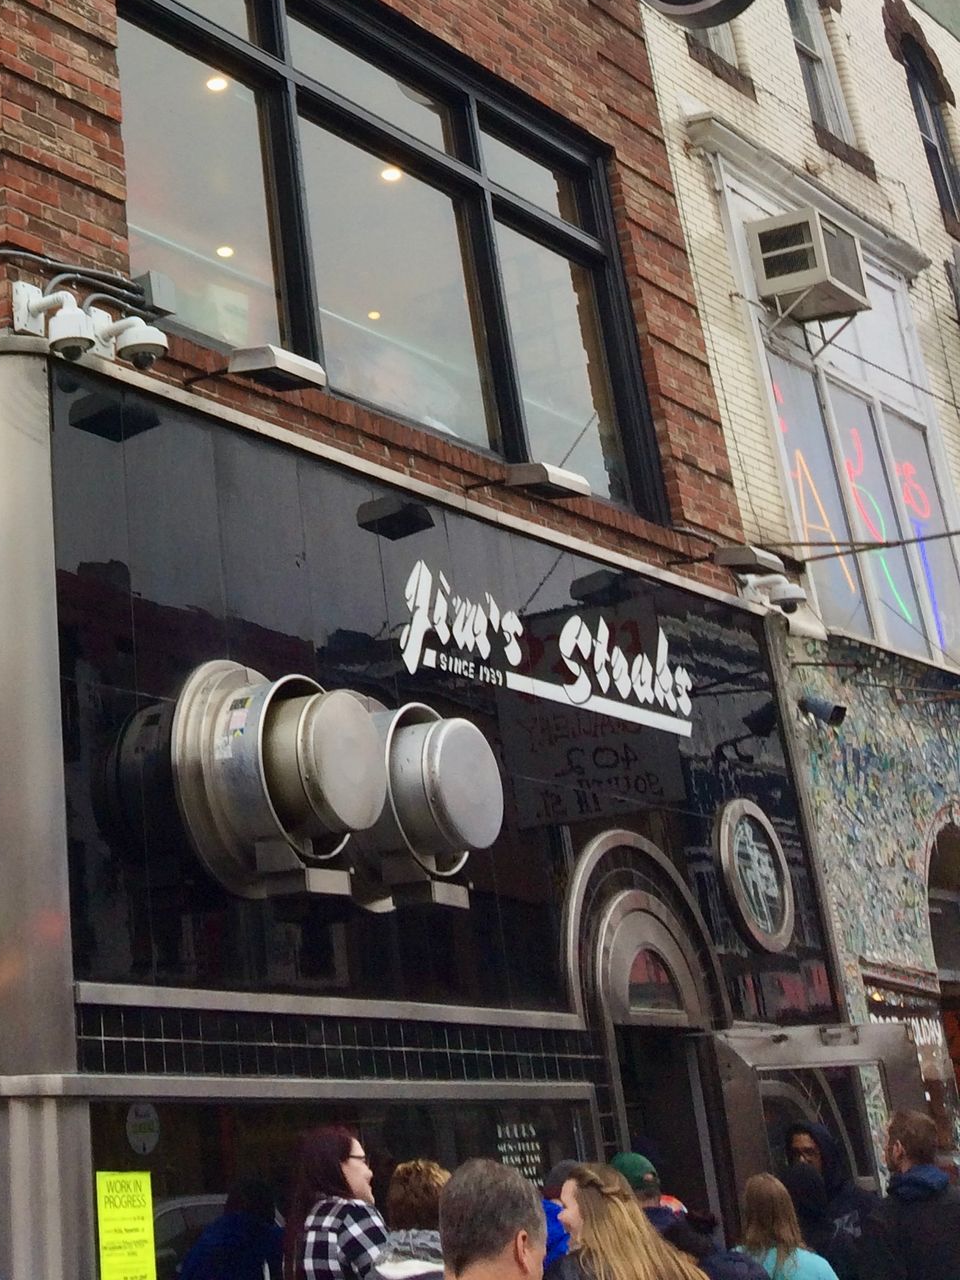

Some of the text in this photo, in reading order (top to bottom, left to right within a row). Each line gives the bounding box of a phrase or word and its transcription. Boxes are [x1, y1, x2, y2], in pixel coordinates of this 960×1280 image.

[399, 559, 692, 717] Jim's Steaks
[439, 652, 503, 687] SINCE 1939
[106, 1179, 142, 1193] WORK IN
[104, 1194, 147, 1209] PROGRESS
